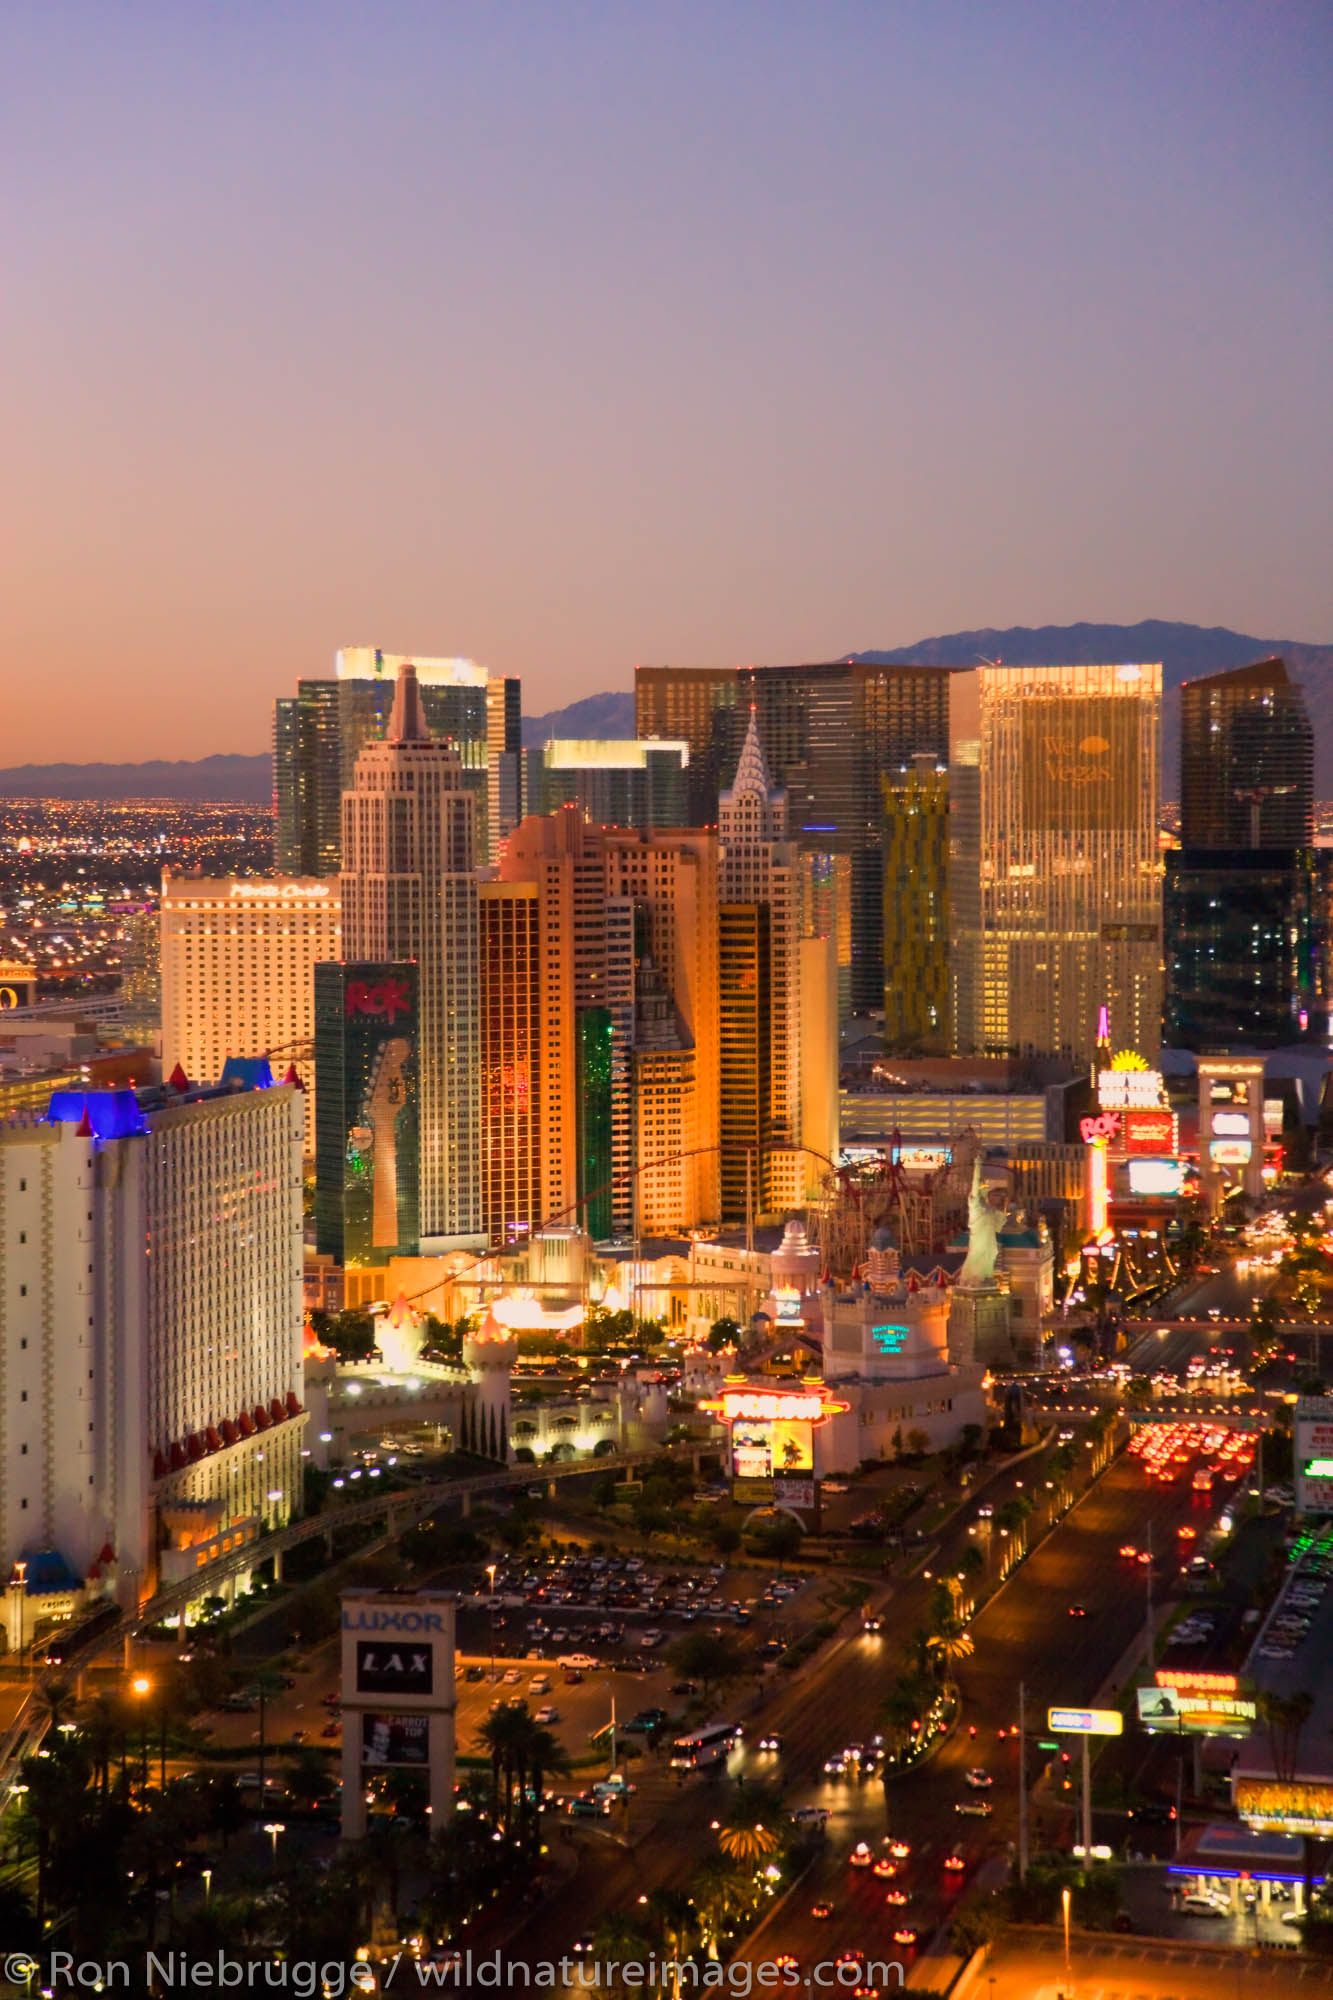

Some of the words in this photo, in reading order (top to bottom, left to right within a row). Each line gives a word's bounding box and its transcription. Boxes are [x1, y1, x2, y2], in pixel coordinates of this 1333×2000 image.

[230, 884, 280, 897] Monte
[281, 884, 329, 897] Carlo
[341, 1611, 447, 1633] LUXOR
[362, 1653, 427, 1672] LAX
